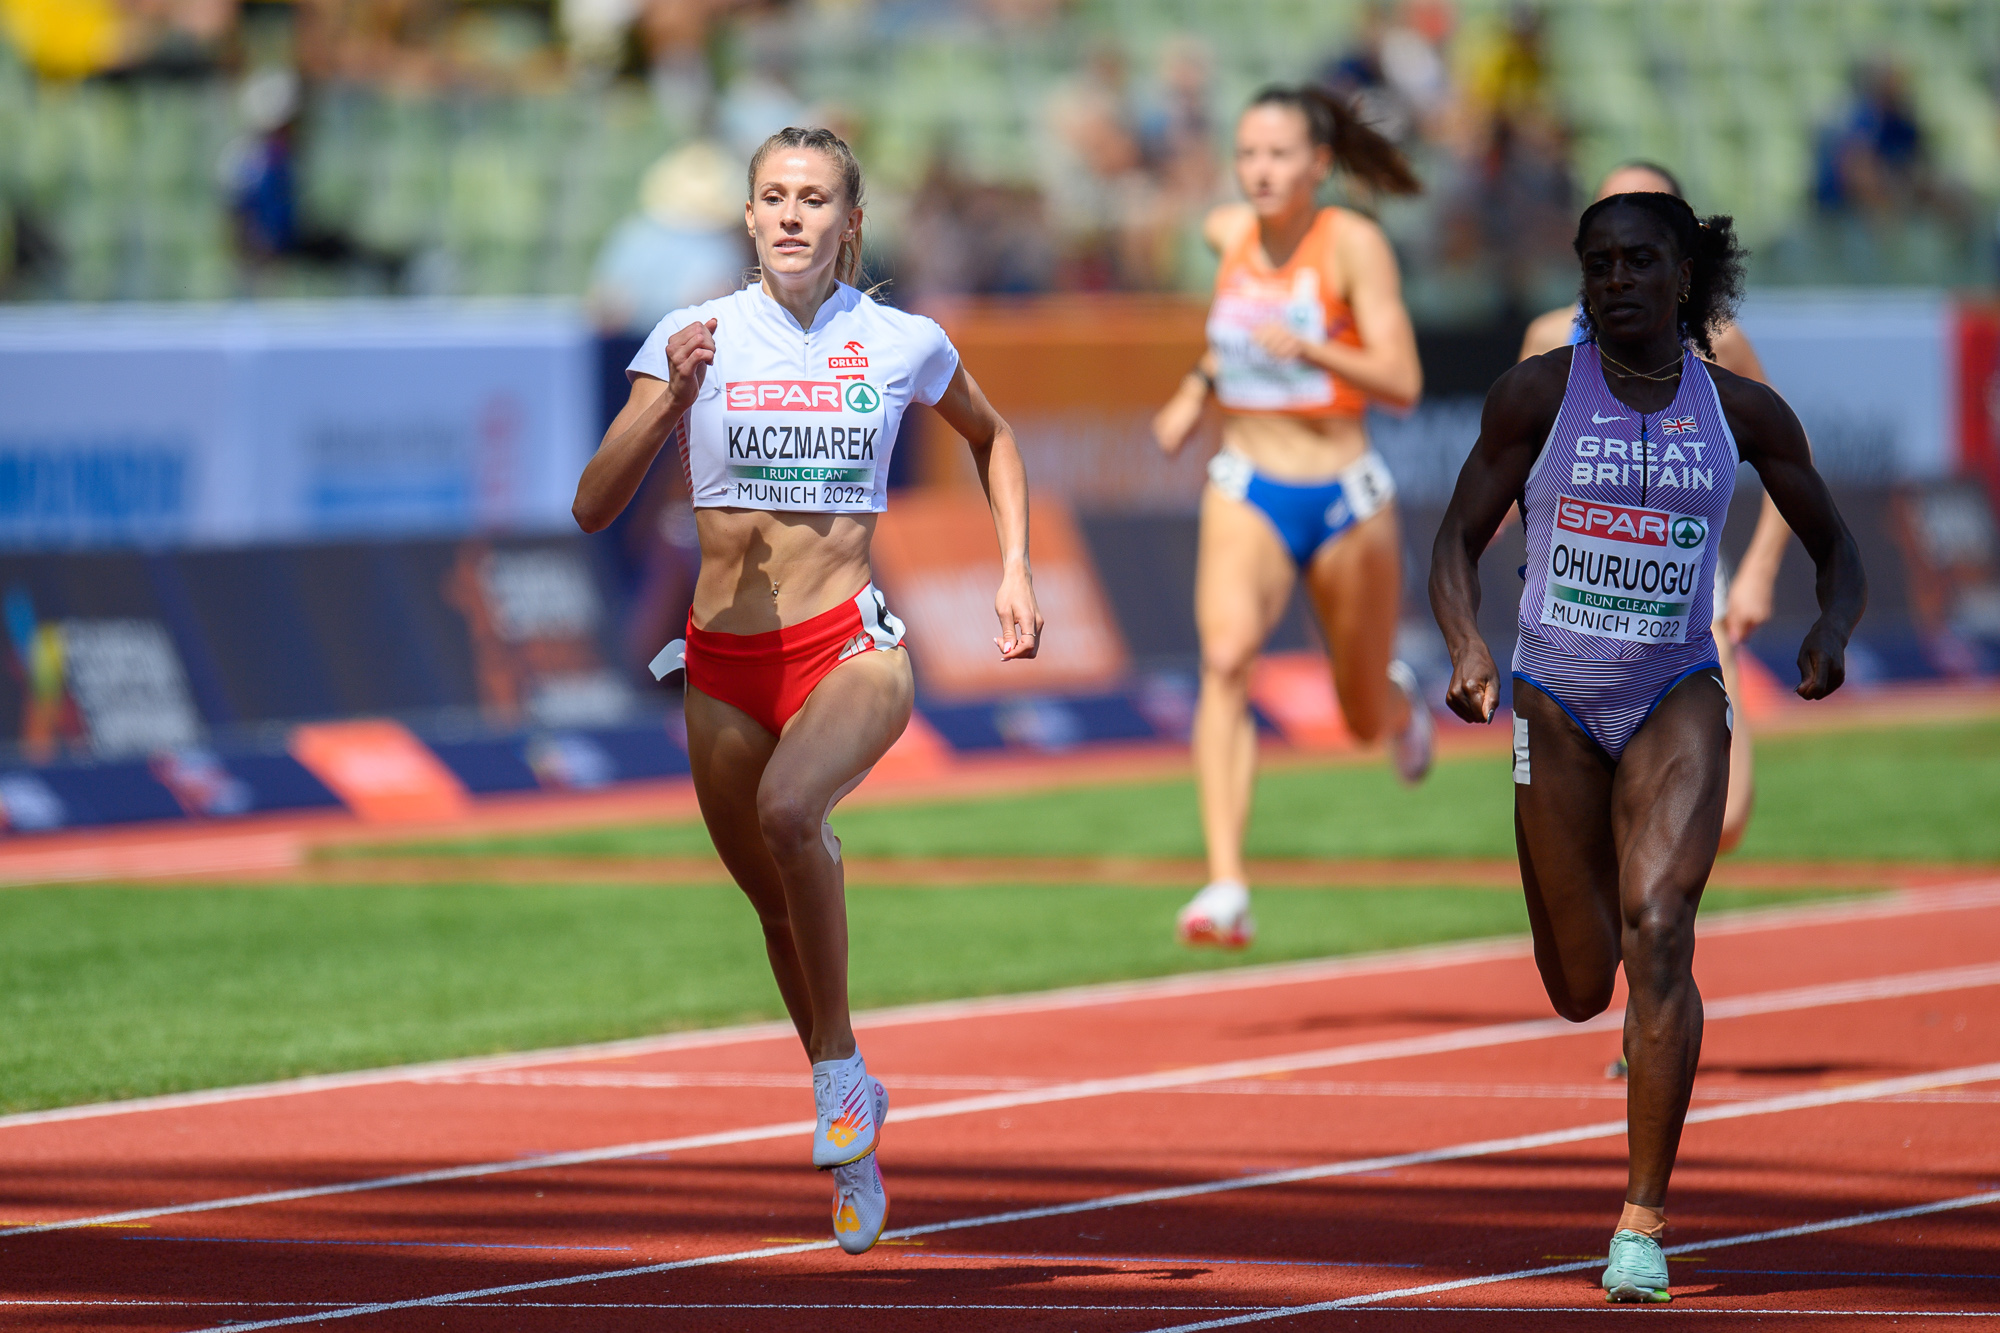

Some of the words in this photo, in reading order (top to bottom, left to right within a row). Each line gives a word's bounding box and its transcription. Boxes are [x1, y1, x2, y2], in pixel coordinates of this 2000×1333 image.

[830, 358, 867, 368] ORLEN
[729, 384, 839, 408] SPAR
[728, 426, 878, 461] KACZMAREK
[1575, 435, 1707, 462] GREAT
[762, 468, 766, 478] I
[769, 469, 798, 480] RUN
[1571, 462, 1713, 491] BRITAIN
[737, 482, 816, 504] MUNICH
[823, 486, 865, 504] 2022
[1560, 502, 1666, 542] SPAR
[1552, 544, 1695, 596] OHURUOGU
[1577, 592, 1582, 602] I
[1585, 593, 1613, 608] RUN
[1552, 602, 1630, 634] MUNICH
[1637, 619, 1680, 638] 2022
